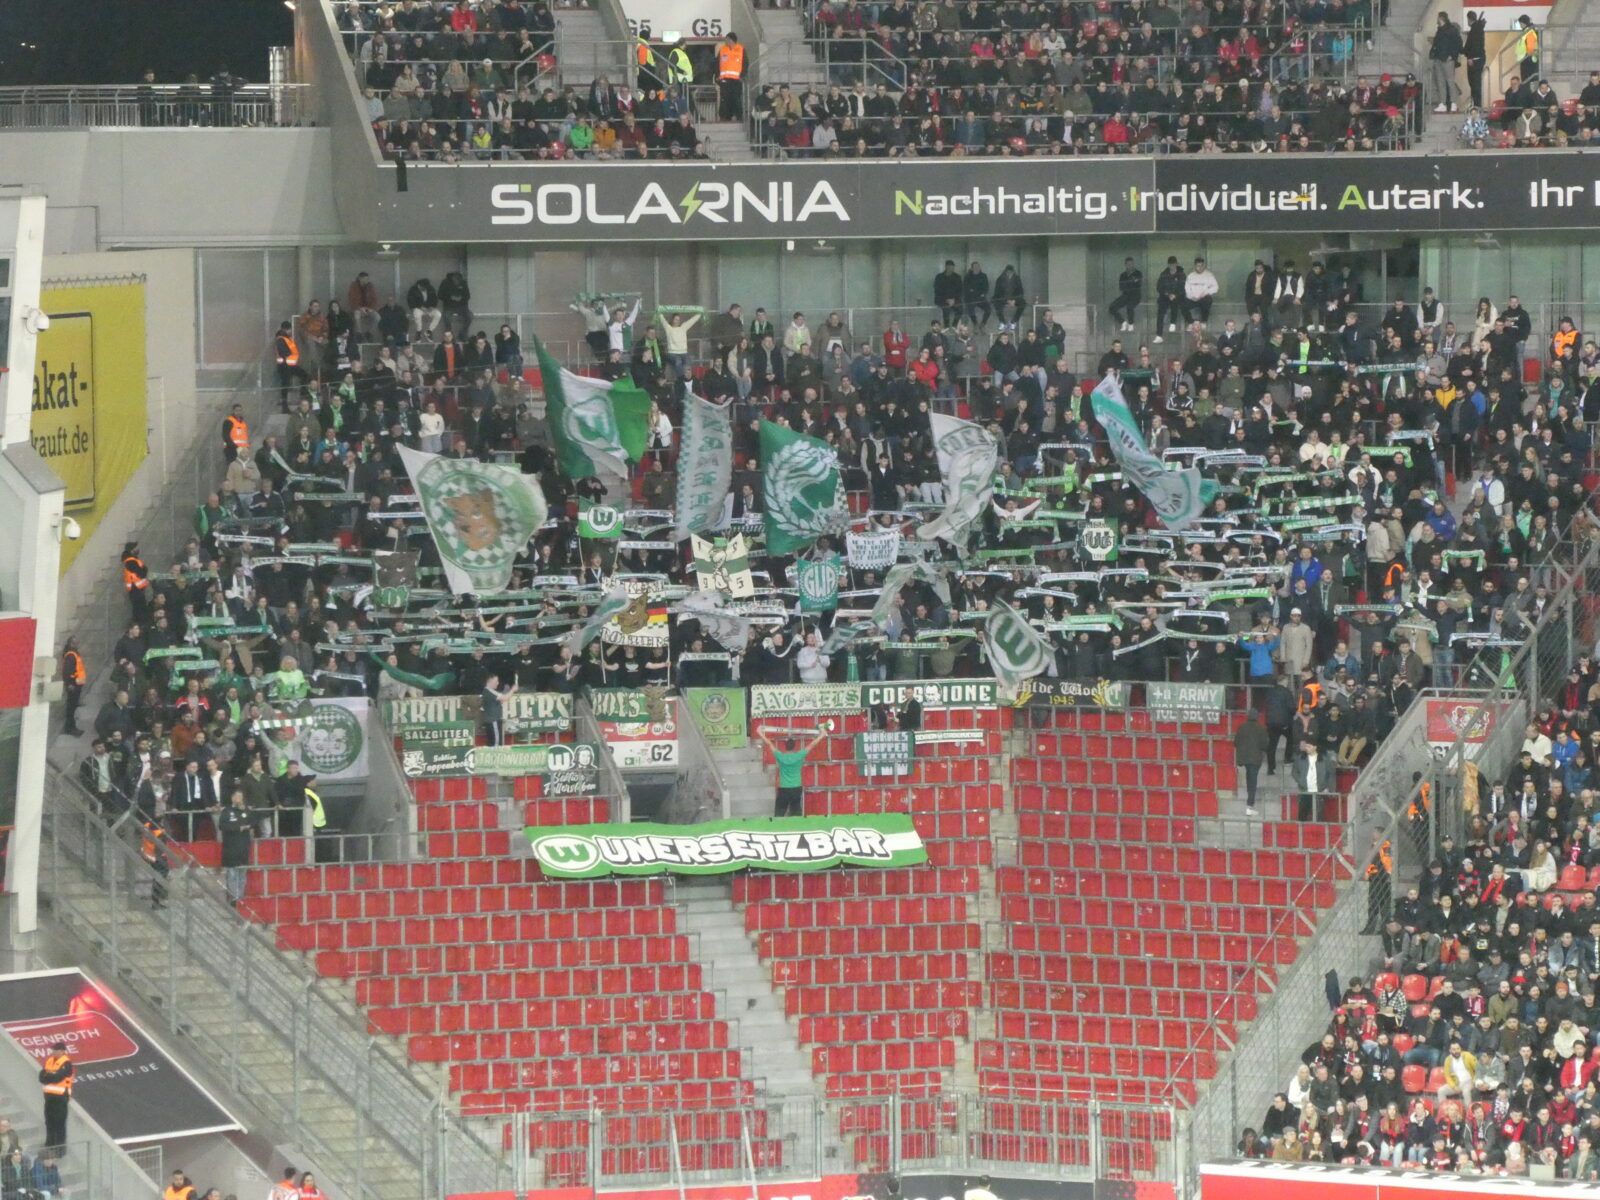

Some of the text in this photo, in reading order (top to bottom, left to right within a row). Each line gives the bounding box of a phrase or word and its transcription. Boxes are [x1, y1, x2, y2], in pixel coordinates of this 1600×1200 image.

[692, 18, 722, 37] G5
[895, 185, 1118, 220] Nachhaltig.
[1130, 183, 1328, 212] Individuell.
[1338, 181, 1484, 210] Autark.
[1530, 178, 1585, 208] Ihr
[1179, 686, 1217, 702] ARMY
[404, 728, 470, 740] SALZGITTER
[651, 744, 673, 762] G2
[598, 828, 891, 866] UNERSETZBAR
